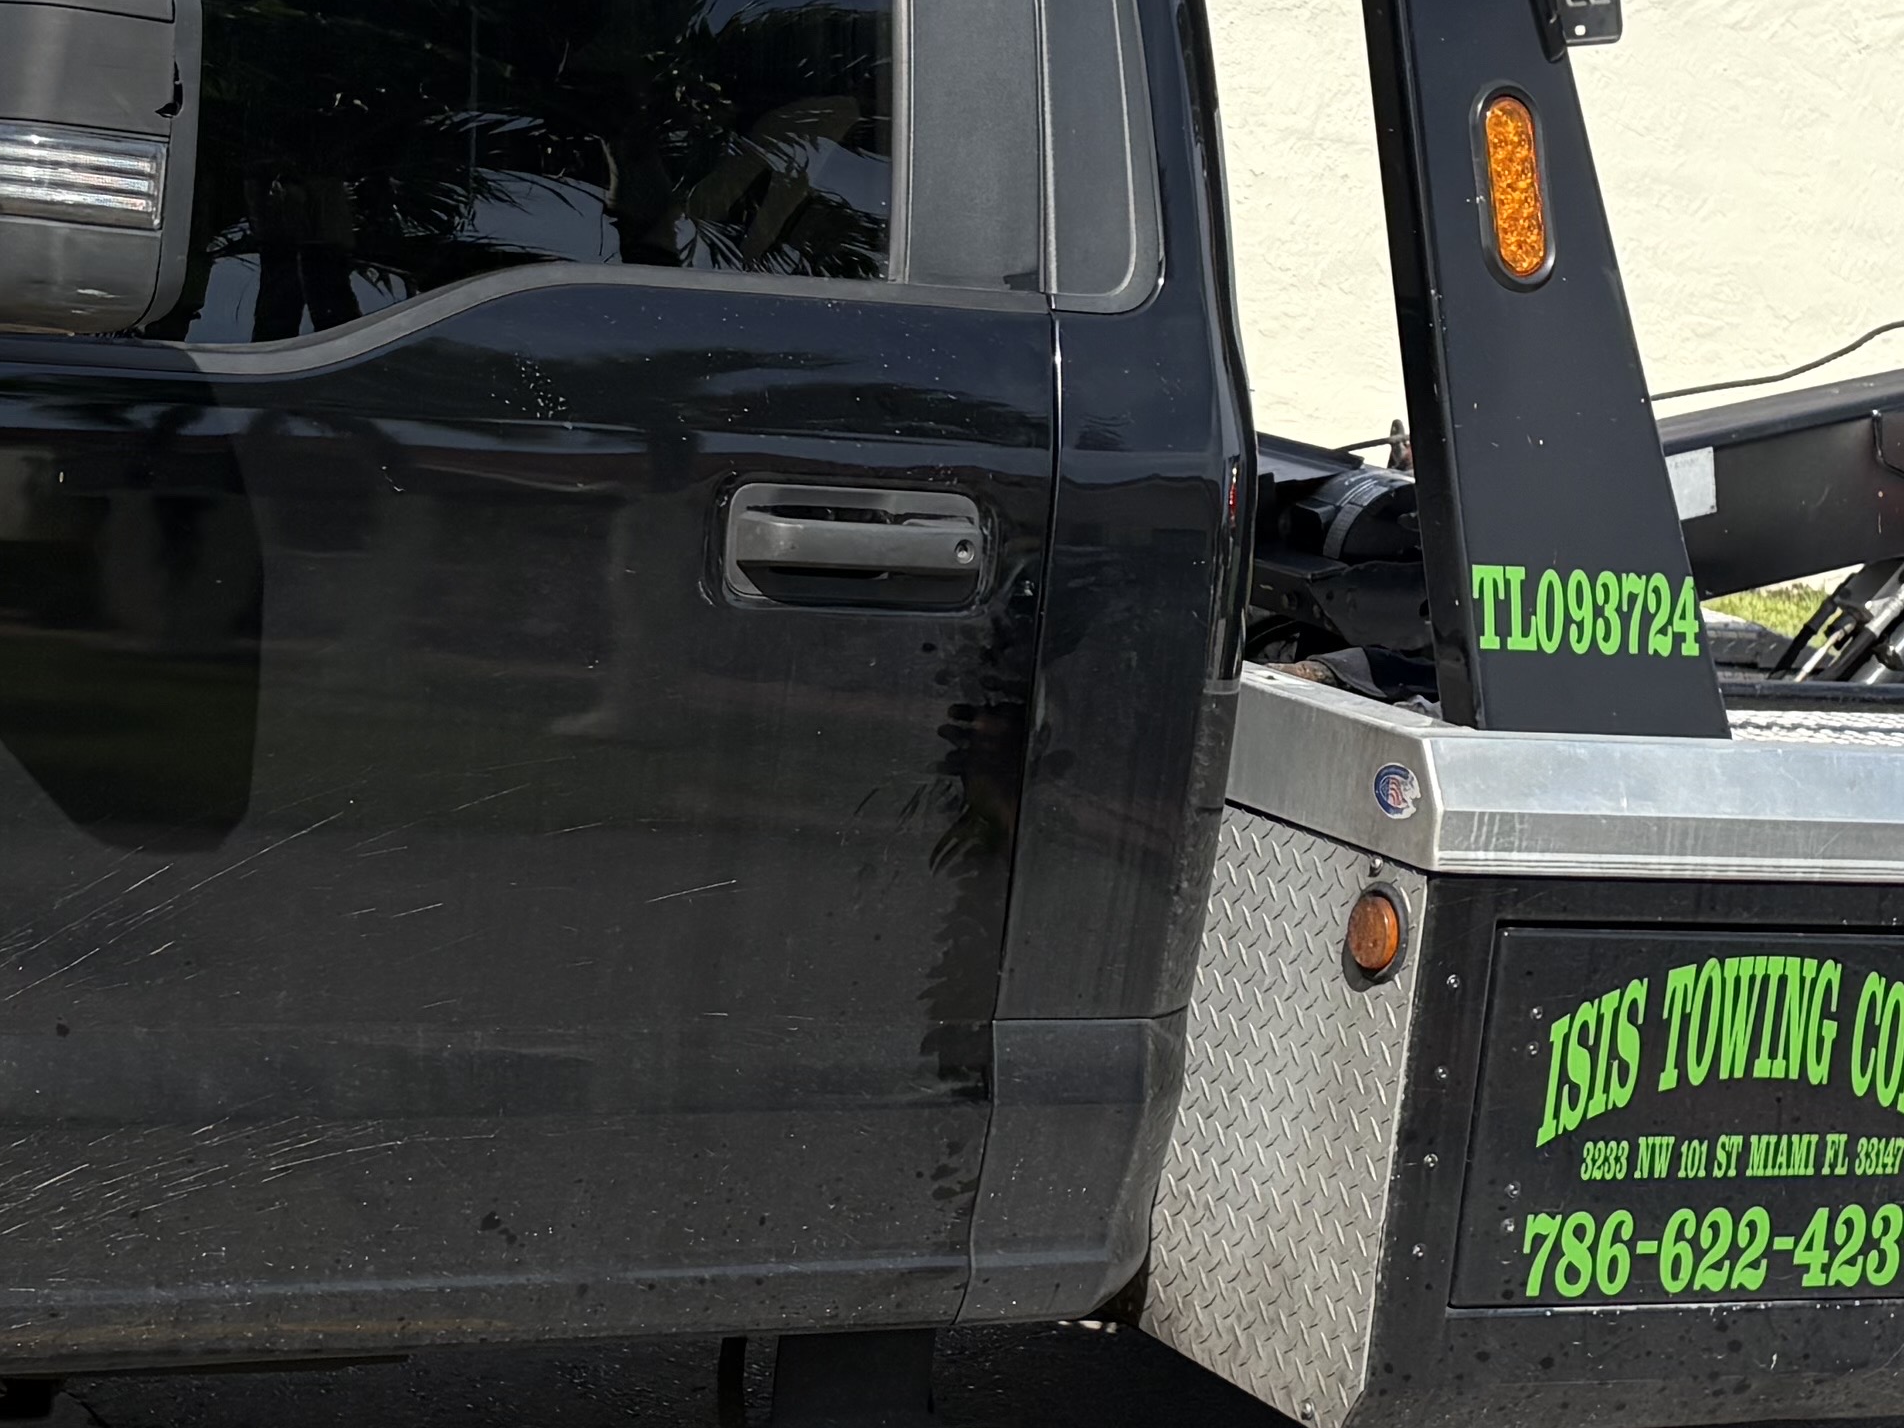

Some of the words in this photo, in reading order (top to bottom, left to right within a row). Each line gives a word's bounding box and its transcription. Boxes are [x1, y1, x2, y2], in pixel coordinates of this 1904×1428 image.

[1535, 977, 1649, 1148] ISIS
[1658, 955, 1843, 1092] TOWING
[1580, 1140, 1630, 1181] 3233
[1634, 1136, 1676, 1180] NW
[1678, 1139, 1709, 1179] 101
[1713, 1134, 1744, 1178] ST
[1745, 1133, 1820, 1177] MIAMI
[1822, 1133, 1849, 1176] FL
